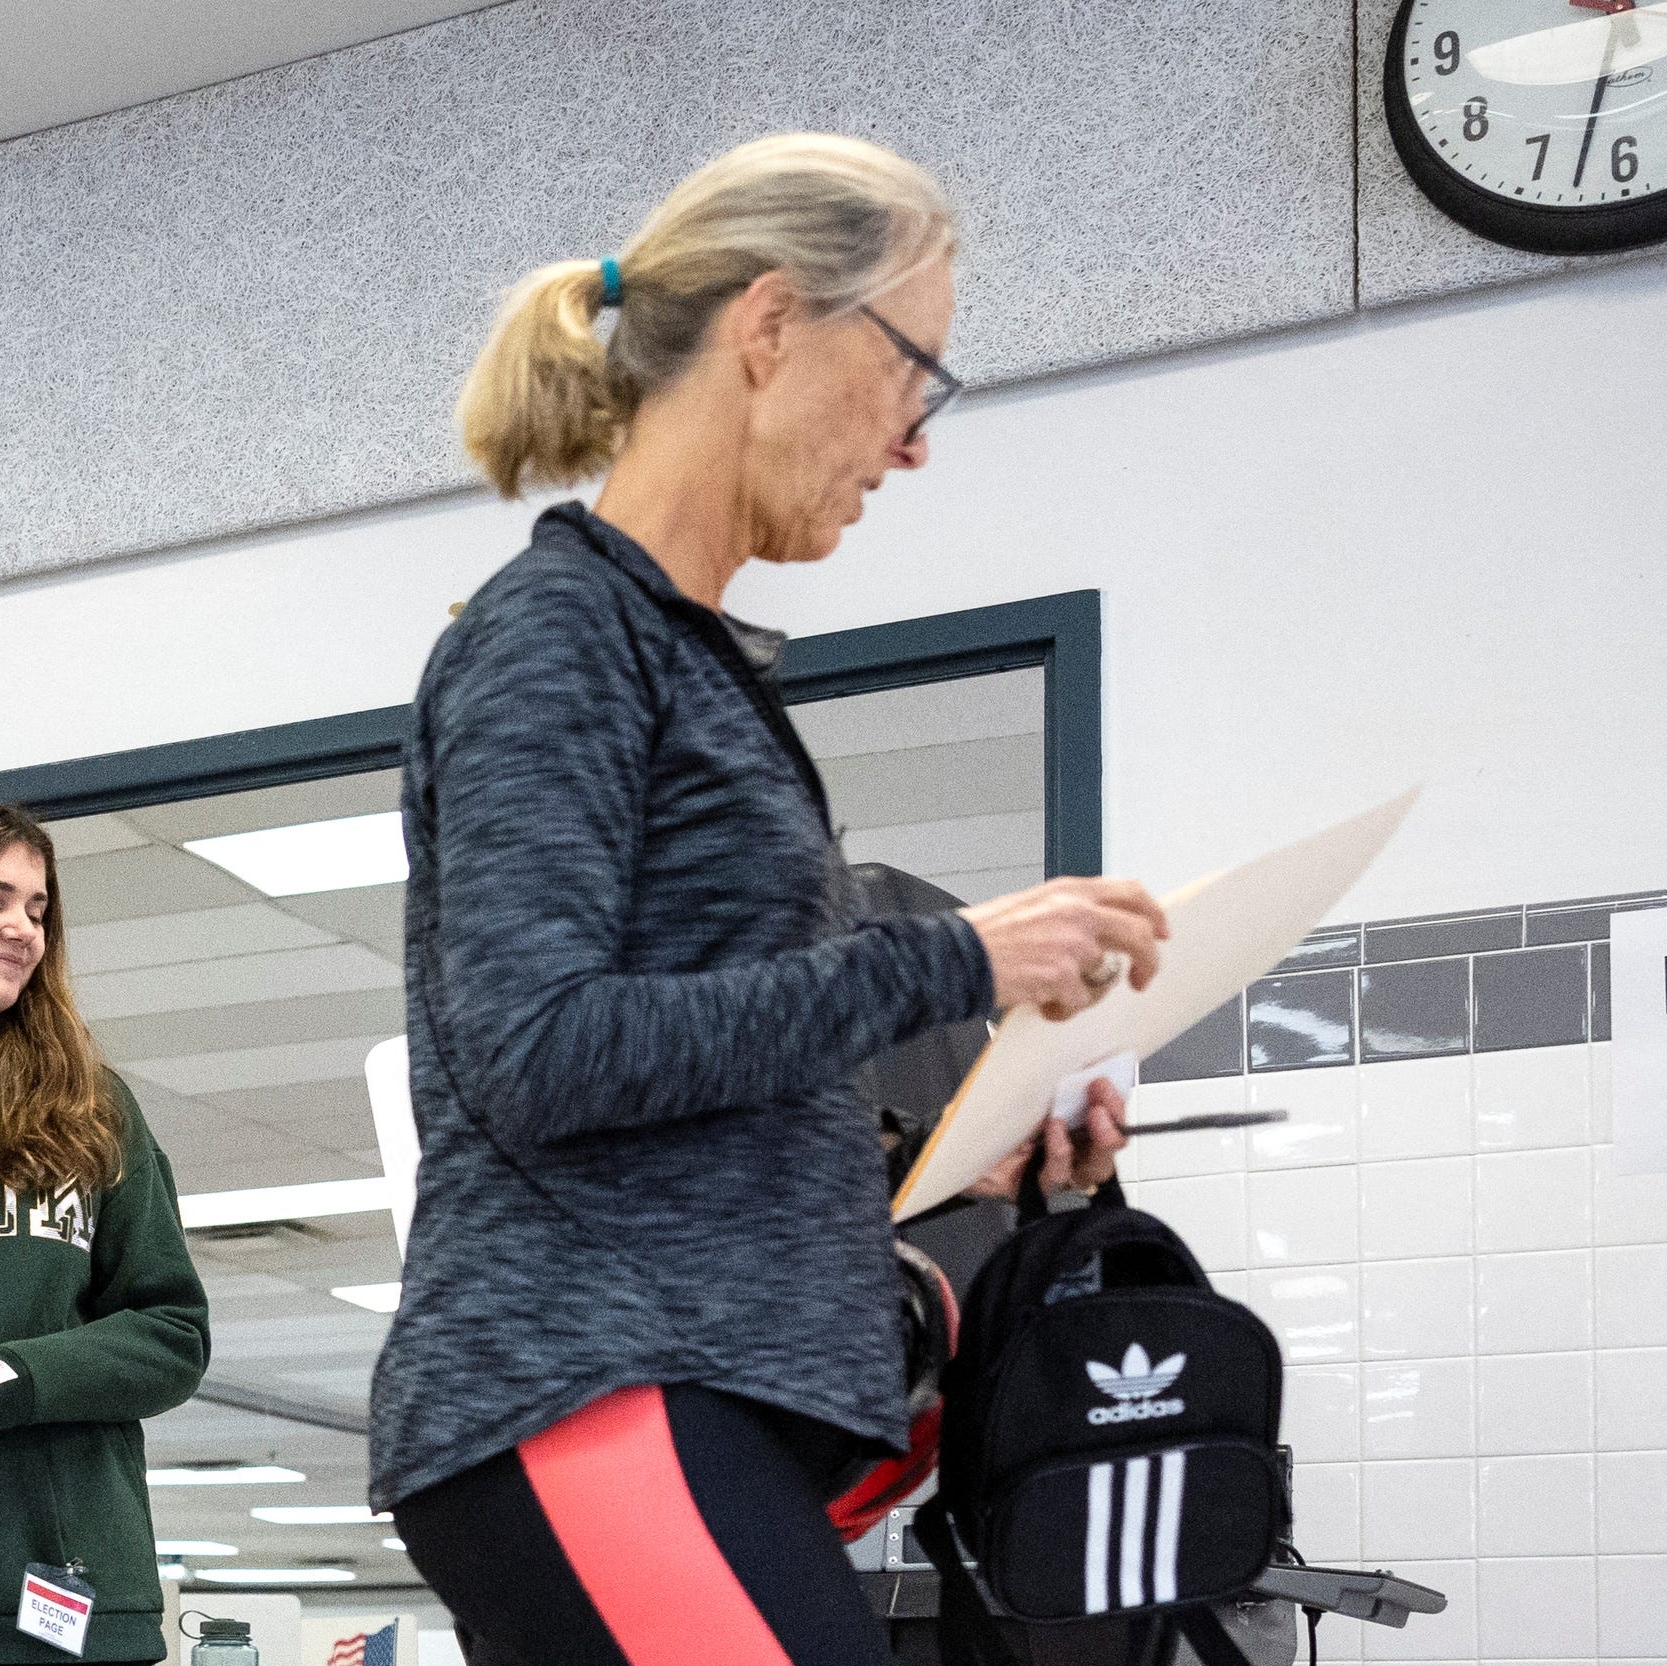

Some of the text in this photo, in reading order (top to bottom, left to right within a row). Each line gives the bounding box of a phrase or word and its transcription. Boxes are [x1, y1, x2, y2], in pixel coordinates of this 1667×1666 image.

[1433, 30, 1461, 76] 9
[1607, 70, 1646, 84] athem
[1462, 95, 1490, 142] 8
[1525, 133, 1551, 182] 7
[1610, 135, 1639, 183] 6
[1086, 1397, 1186, 1426] adidas
[31, 1598, 77, 1627] ELECTION
[38, 1617, 64, 1636] PAGE
